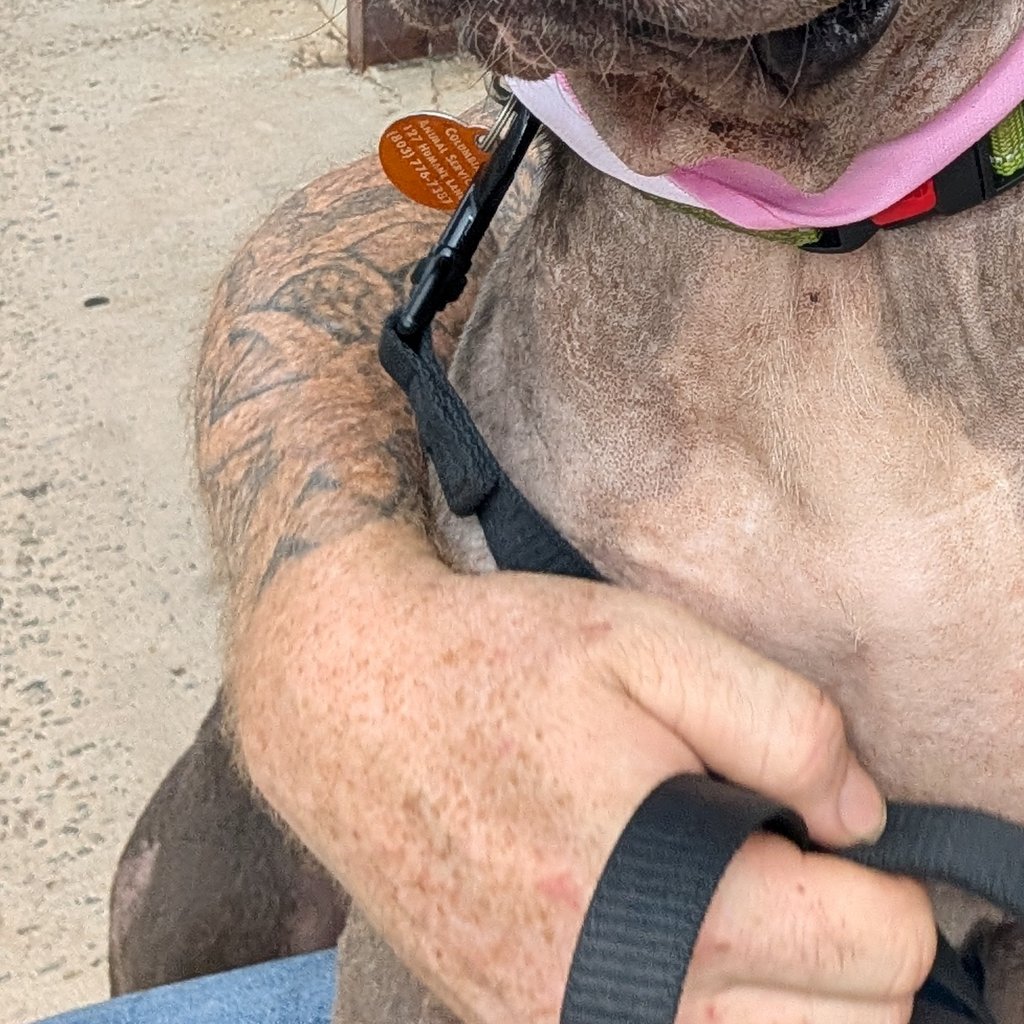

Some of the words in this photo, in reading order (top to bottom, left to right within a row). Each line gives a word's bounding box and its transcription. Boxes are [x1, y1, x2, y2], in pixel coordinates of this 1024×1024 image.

[386, 130, 416, 159] (803)
[410, 158, 454, 204] 776-7387
[403, 124, 423, 142] 127
[418, 143, 449, 179] HUMANE
[420, 120, 448, 154] ANIMAL
[445, 154, 473, 186] SERVIC
